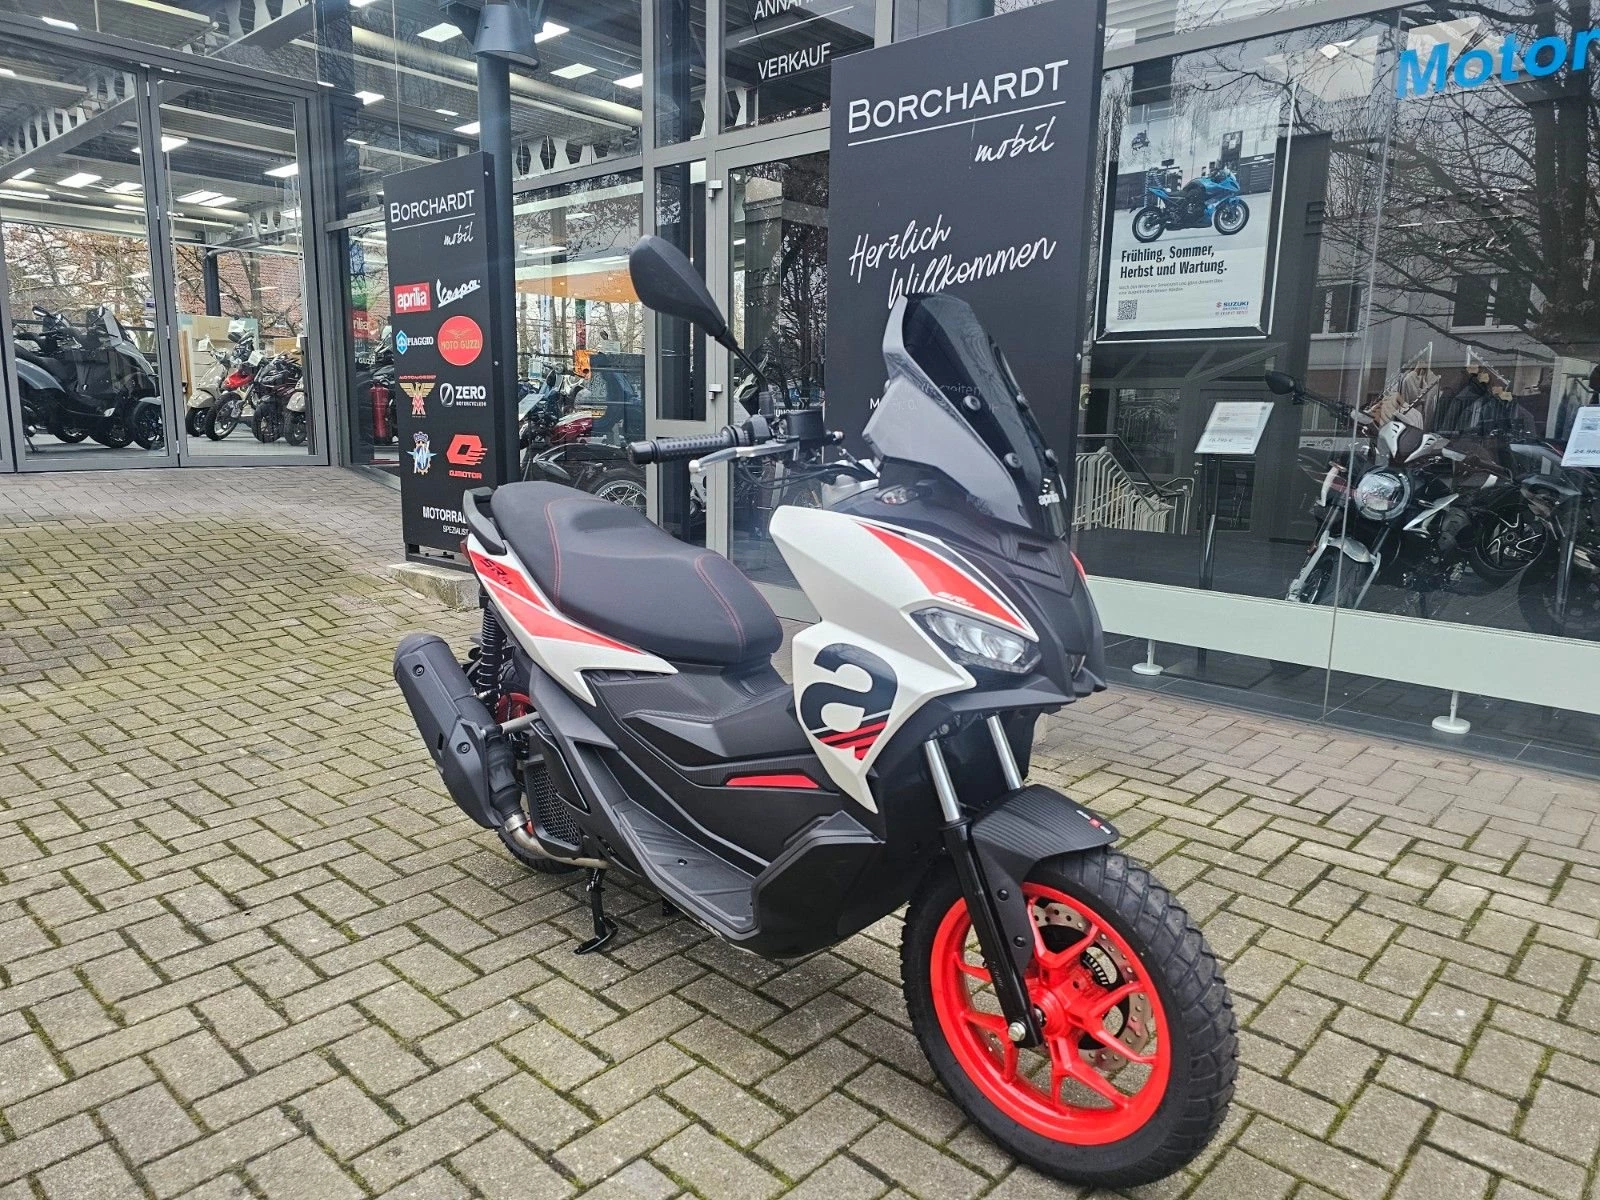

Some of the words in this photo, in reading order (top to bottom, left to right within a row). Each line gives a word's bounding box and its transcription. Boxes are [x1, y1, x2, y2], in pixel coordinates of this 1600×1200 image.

[758, 42, 831, 80] VERKAUF
[1395, 27, 1600, 100] Motor
[848, 59, 1069, 134] BORCHARDT
[974, 115, 1056, 163] mobil
[390, 189, 475, 223] BORCHARDT
[443, 221, 474, 246] mobil
[849, 213, 951, 284] Herzlich
[1121, 248, 1166, 263] Frühling,
[1169, 244, 1215, 260] Sommer,
[888, 236, 1057, 310] Willkommen
[1120, 264, 1154, 279] Herbst
[1156, 262, 1176, 276] und
[1179, 259, 1228, 275] Wartung.
[397, 286, 427, 311] aprilia
[436, 278, 481, 308] Vespa
[407, 336, 434, 347] PIAGGIO
[441, 341, 459, 351] MOTO
[460, 340, 481, 349] GUZZI
[455, 385, 487, 400] ZERO
